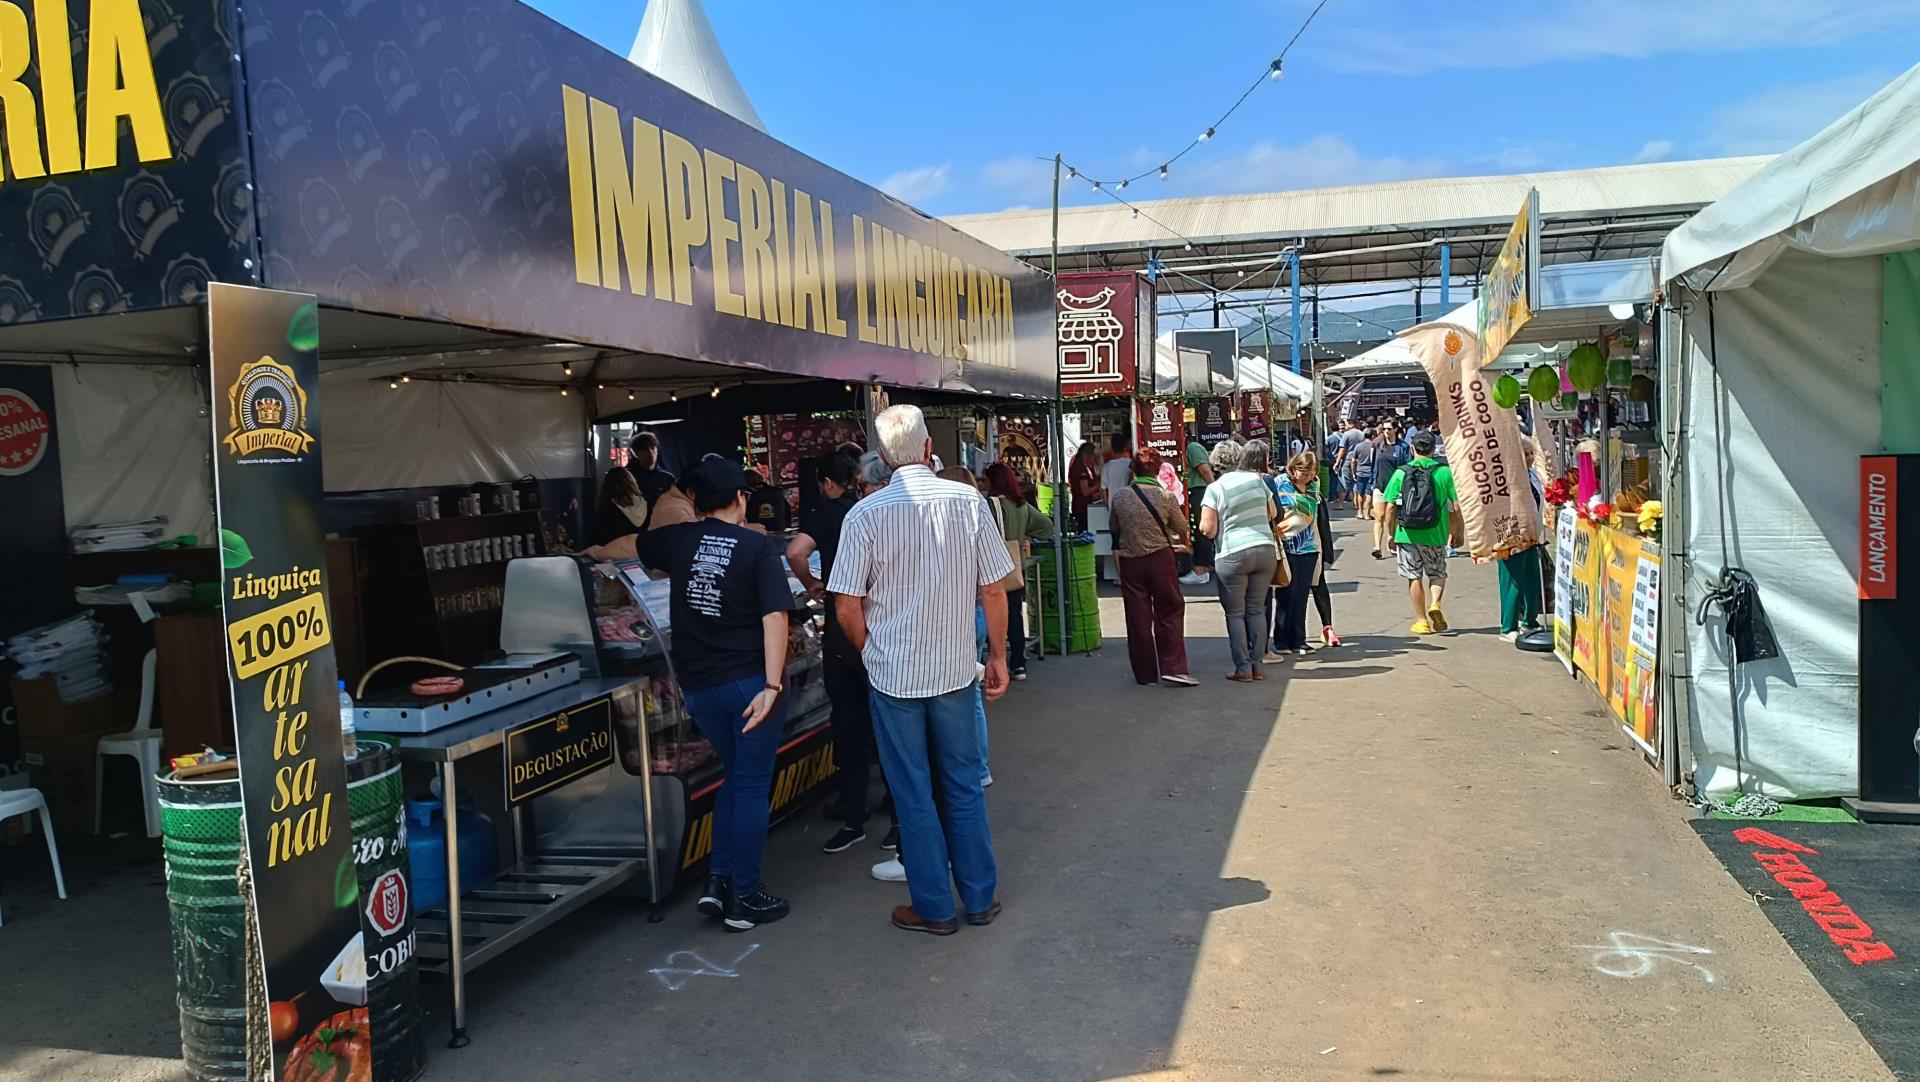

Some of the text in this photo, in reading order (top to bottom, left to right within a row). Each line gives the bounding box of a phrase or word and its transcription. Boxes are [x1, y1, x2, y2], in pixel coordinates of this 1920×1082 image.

[562, 83, 1016, 377] IMPERIAL LINGUIÇARIA
[1201, 432, 1230, 441] quindim
[1448, 381, 1476, 439] DRINKS
[246, 431, 298, 451] Imperial
[1147, 439, 1177, 448] bolinho
[1470, 380, 1511, 497] ÁGUA DE COCO
[1469, 445, 1494, 505] SUCOS,
[1868, 473, 1888, 583] LANÇAMENTO
[232, 565, 321, 600] Linguiça
[237, 606, 324, 667] 100%
[263, 660, 309, 712] ar
[273, 711, 308, 761] te
[514, 731, 608, 784] DEGUSTAÇÃO
[271, 758, 317, 813] sa
[267, 793, 332, 868] nal
[1752, 850, 1898, 967] HONDA
